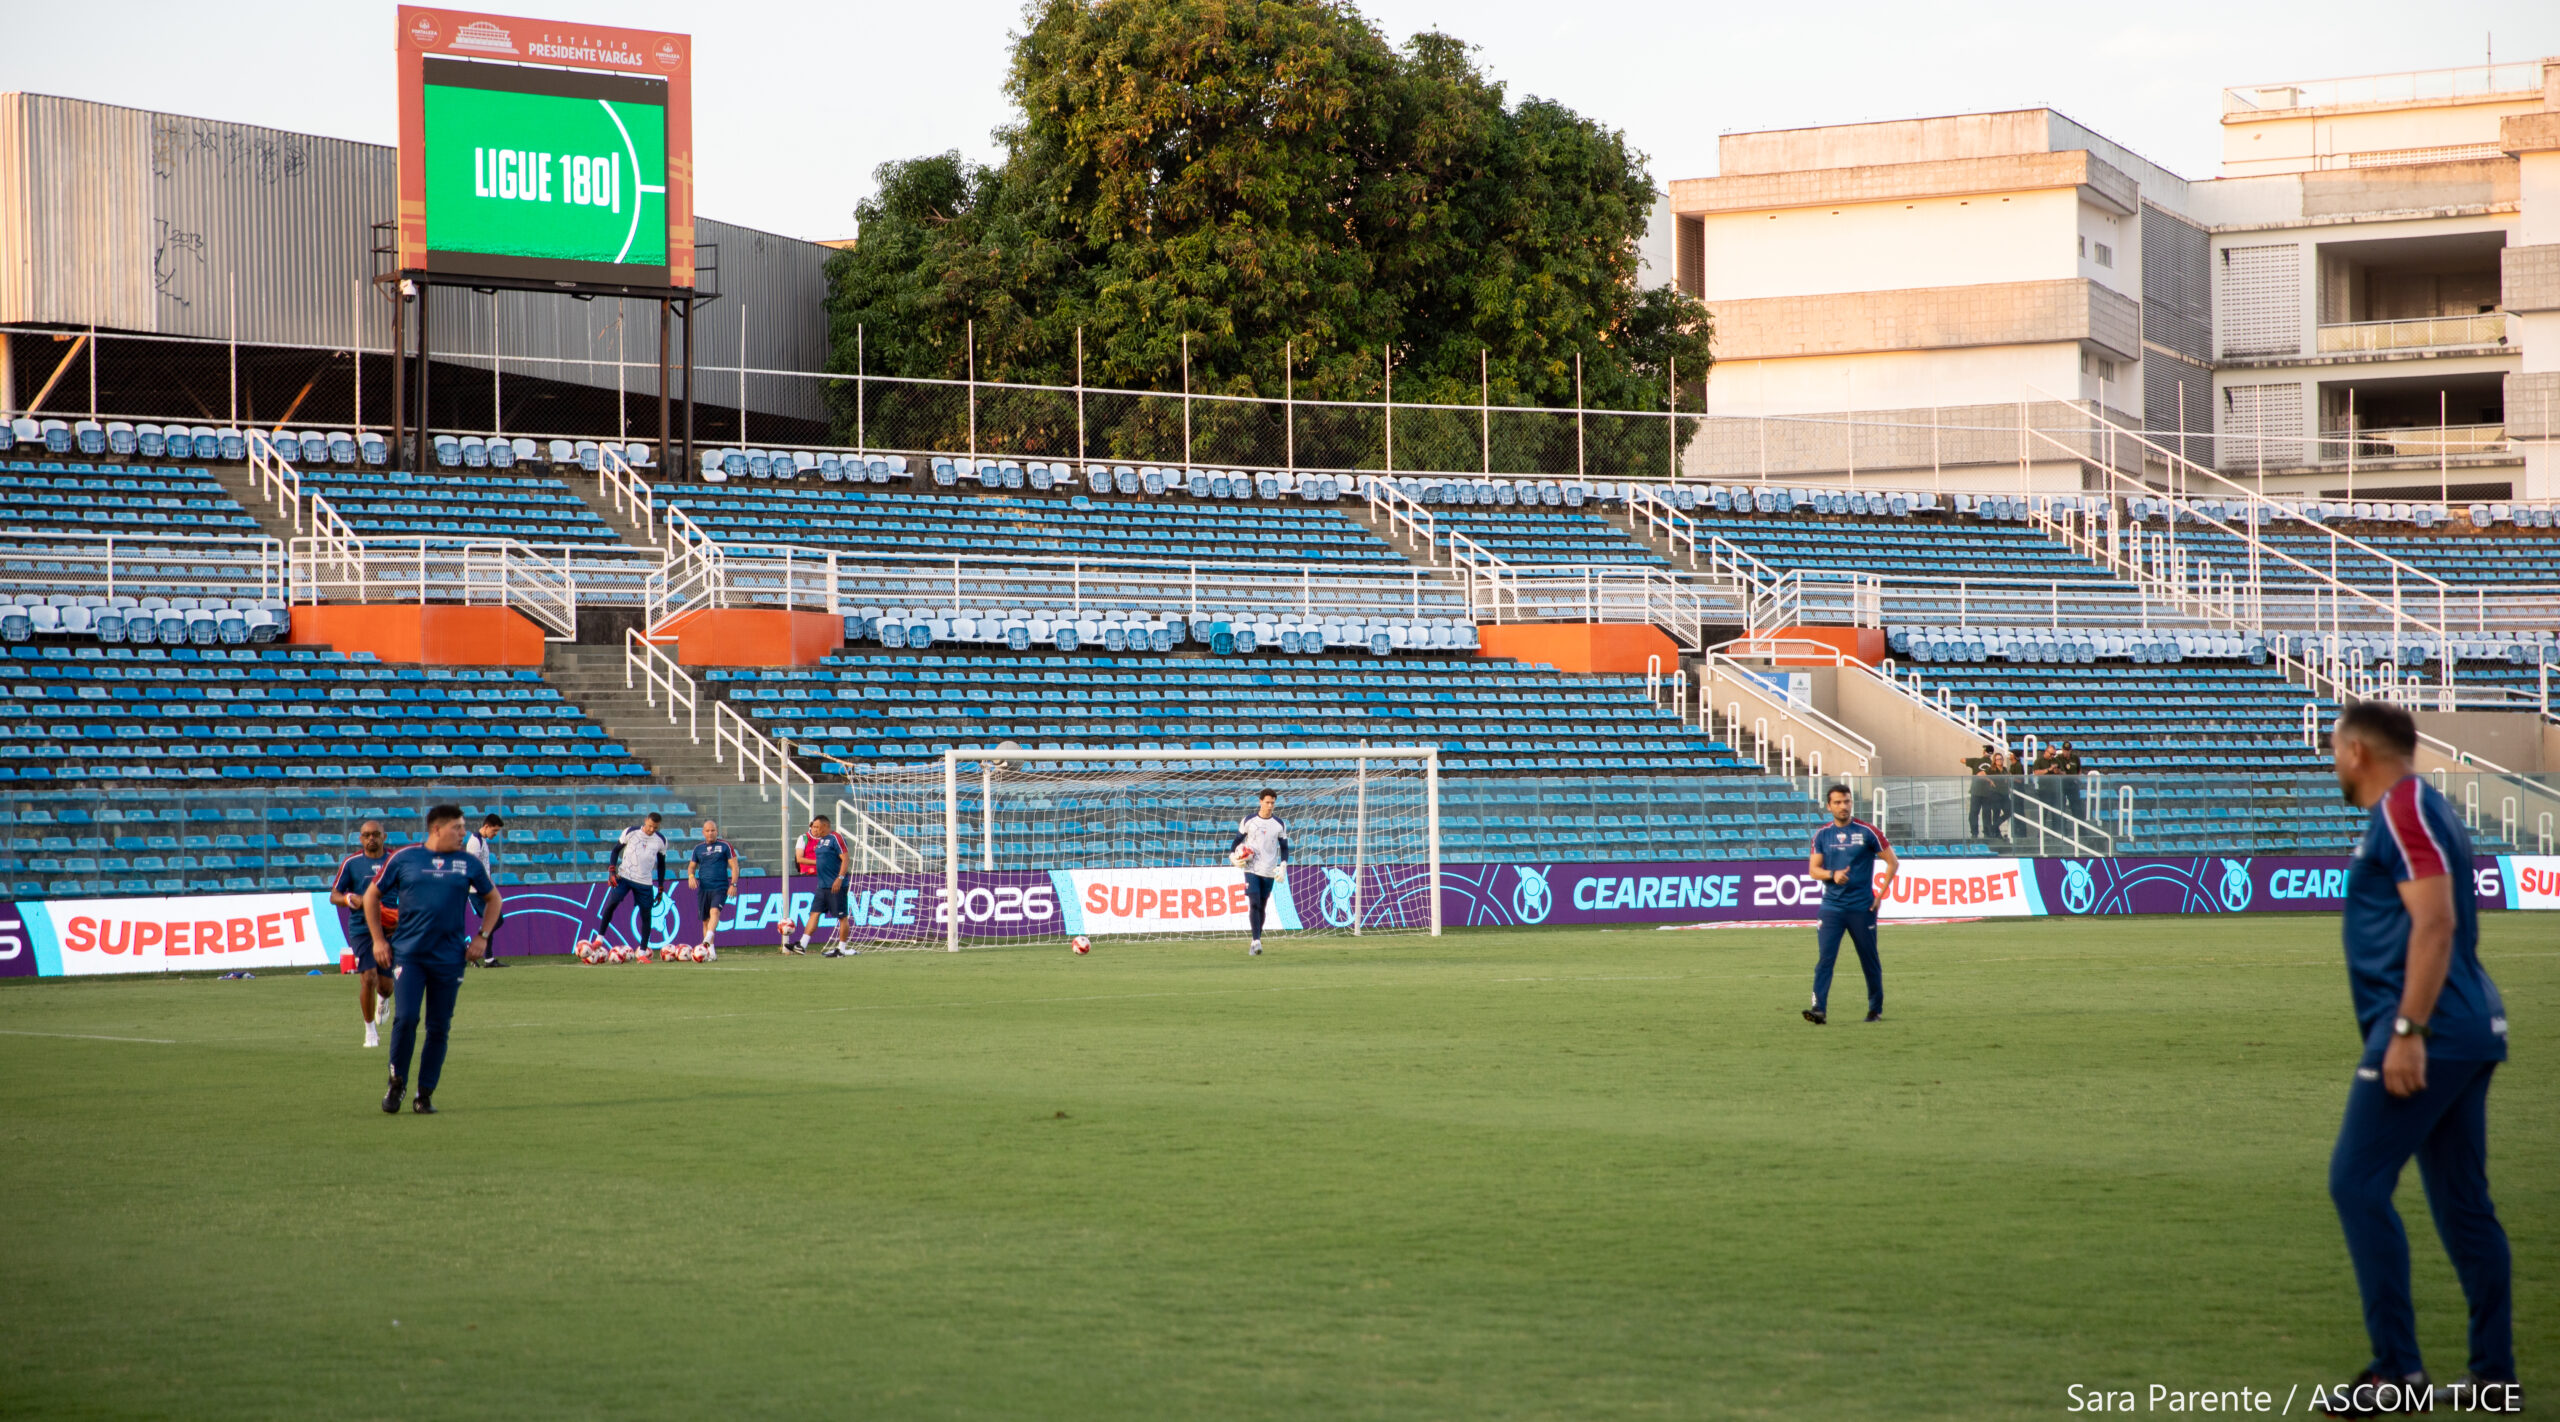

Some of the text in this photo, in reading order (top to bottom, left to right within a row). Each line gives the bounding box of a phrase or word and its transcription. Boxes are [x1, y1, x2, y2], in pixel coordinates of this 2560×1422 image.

[528, 42, 597, 62] PRESIDENTE
[598, 49, 643, 66] VARGAS
[475, 147, 552, 202] LIGUE
[1573, 874, 1826, 911] CEARENSE 202
[1873, 869, 2019, 905] SUPERBET
[65, 907, 310, 956] SUPERBET
